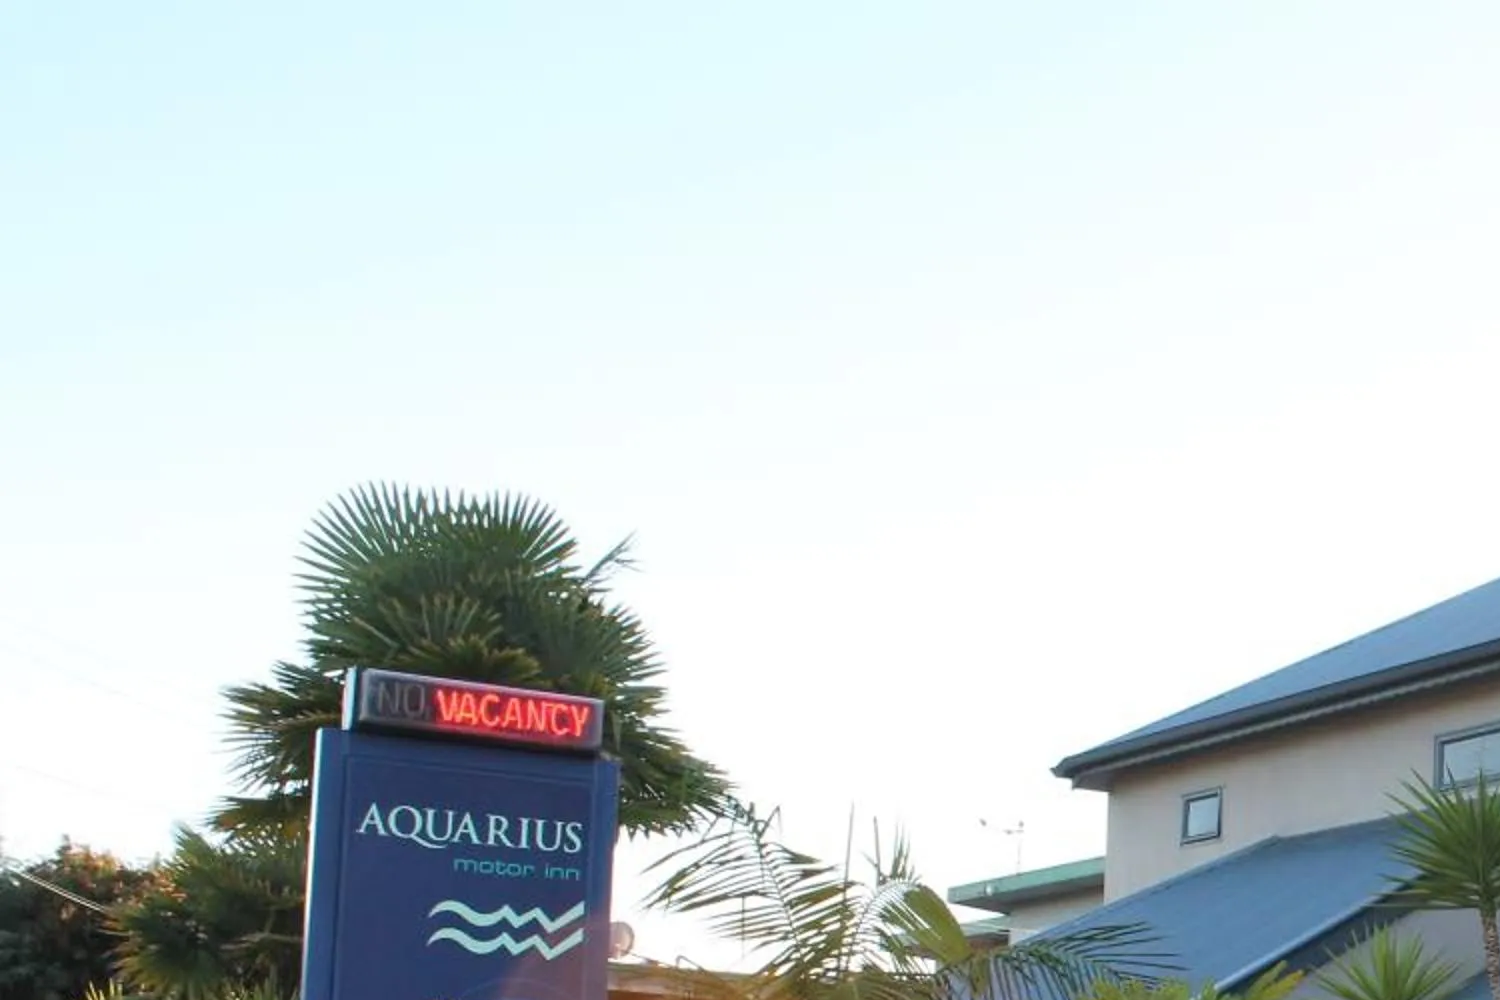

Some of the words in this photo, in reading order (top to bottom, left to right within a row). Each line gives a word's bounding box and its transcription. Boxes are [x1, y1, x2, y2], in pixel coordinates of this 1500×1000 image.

[378, 681, 425, 717] NO
[437, 689, 590, 736] VACANCY
[356, 803, 583, 853] AQUARIUS
[453, 857, 535, 877] motor
[545, 863, 580, 881] inn
